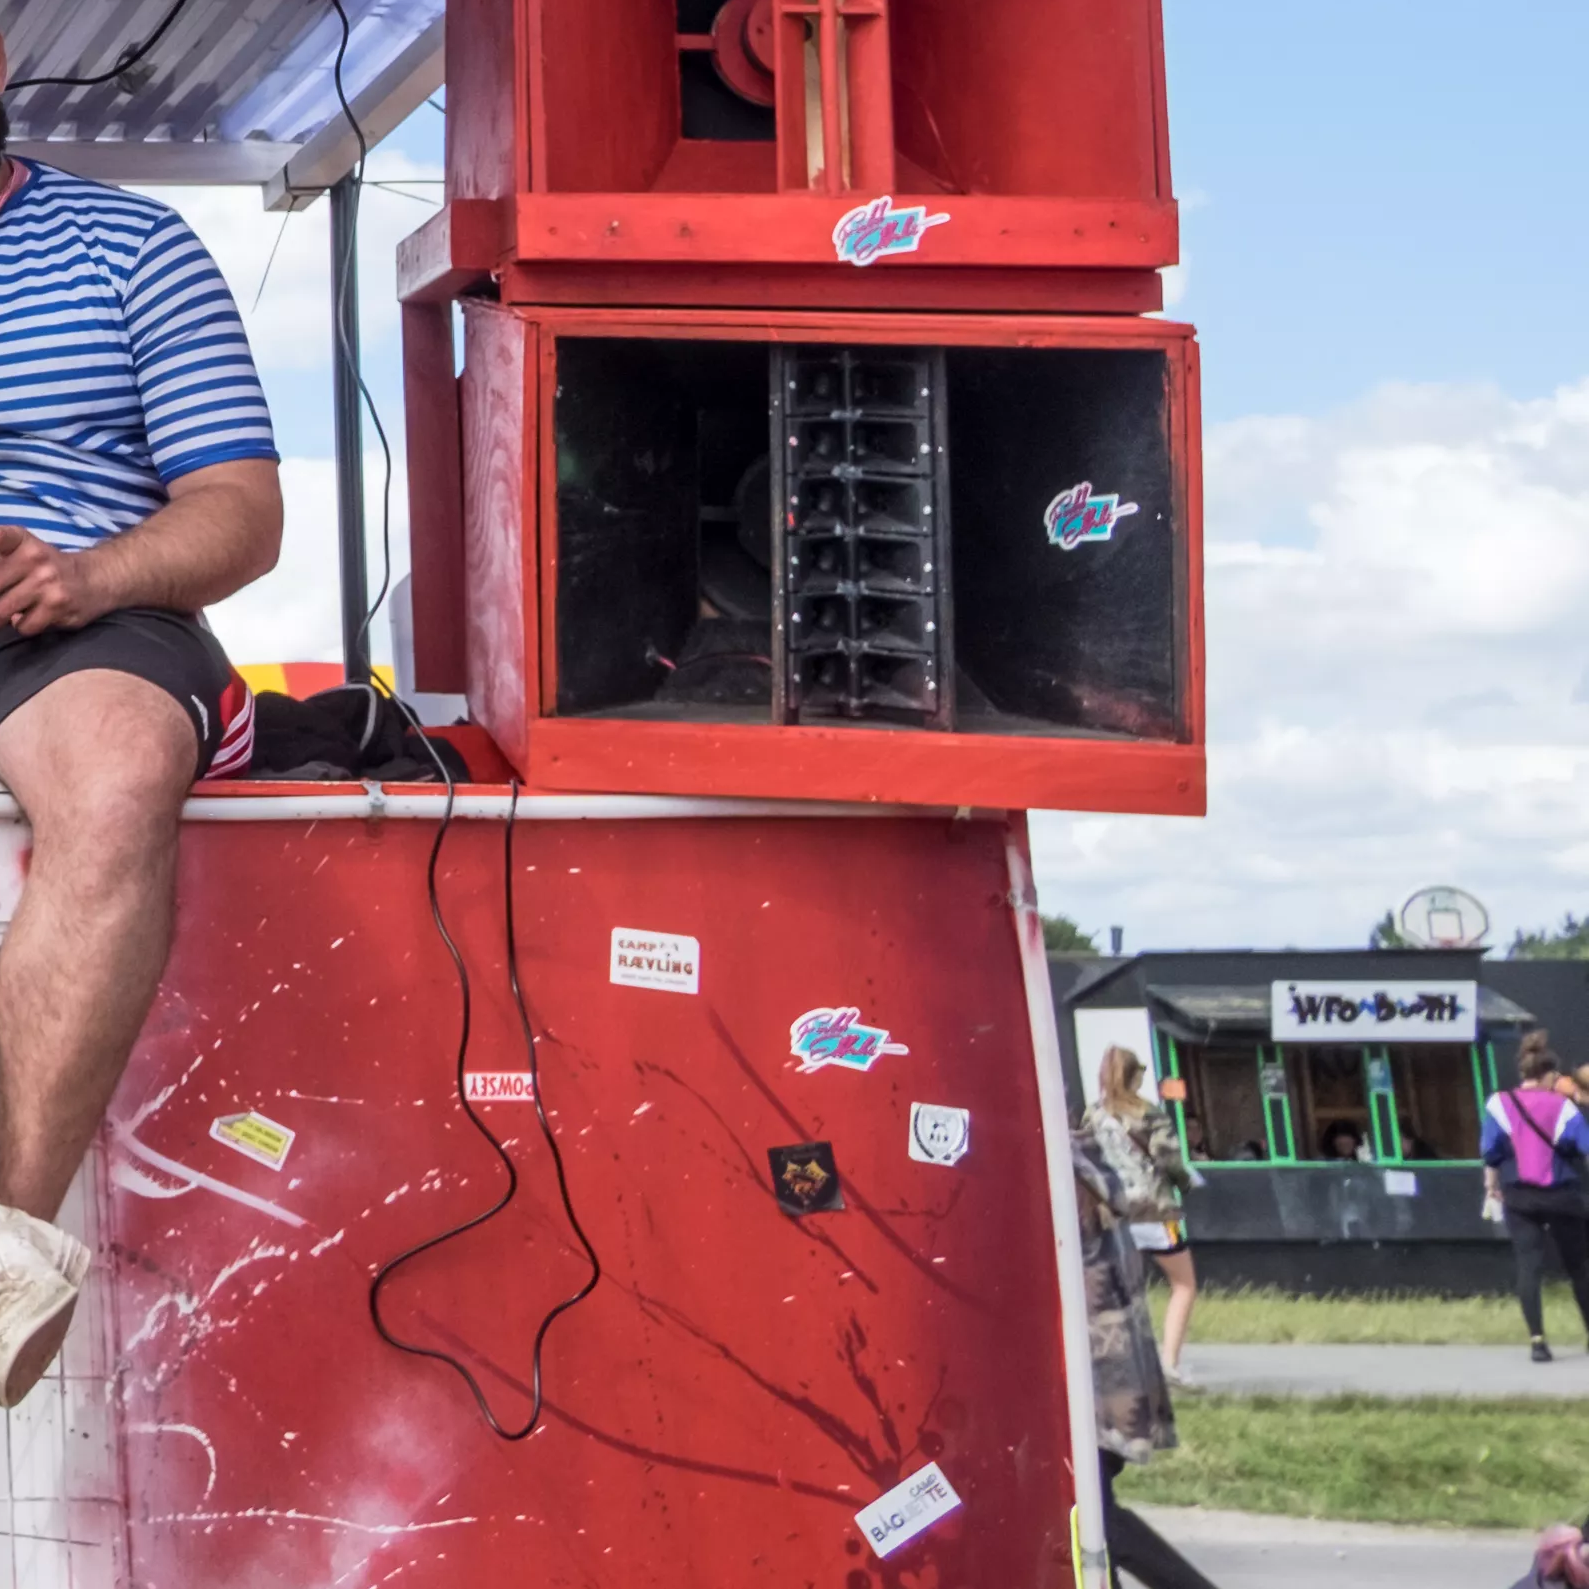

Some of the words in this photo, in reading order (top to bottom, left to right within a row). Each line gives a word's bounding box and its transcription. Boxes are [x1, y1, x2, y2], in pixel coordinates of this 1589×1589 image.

[617, 938, 658, 952] CAMP
[469, 1075, 535, 1097] POWSEY
[909, 1473, 937, 1498] CAMP
